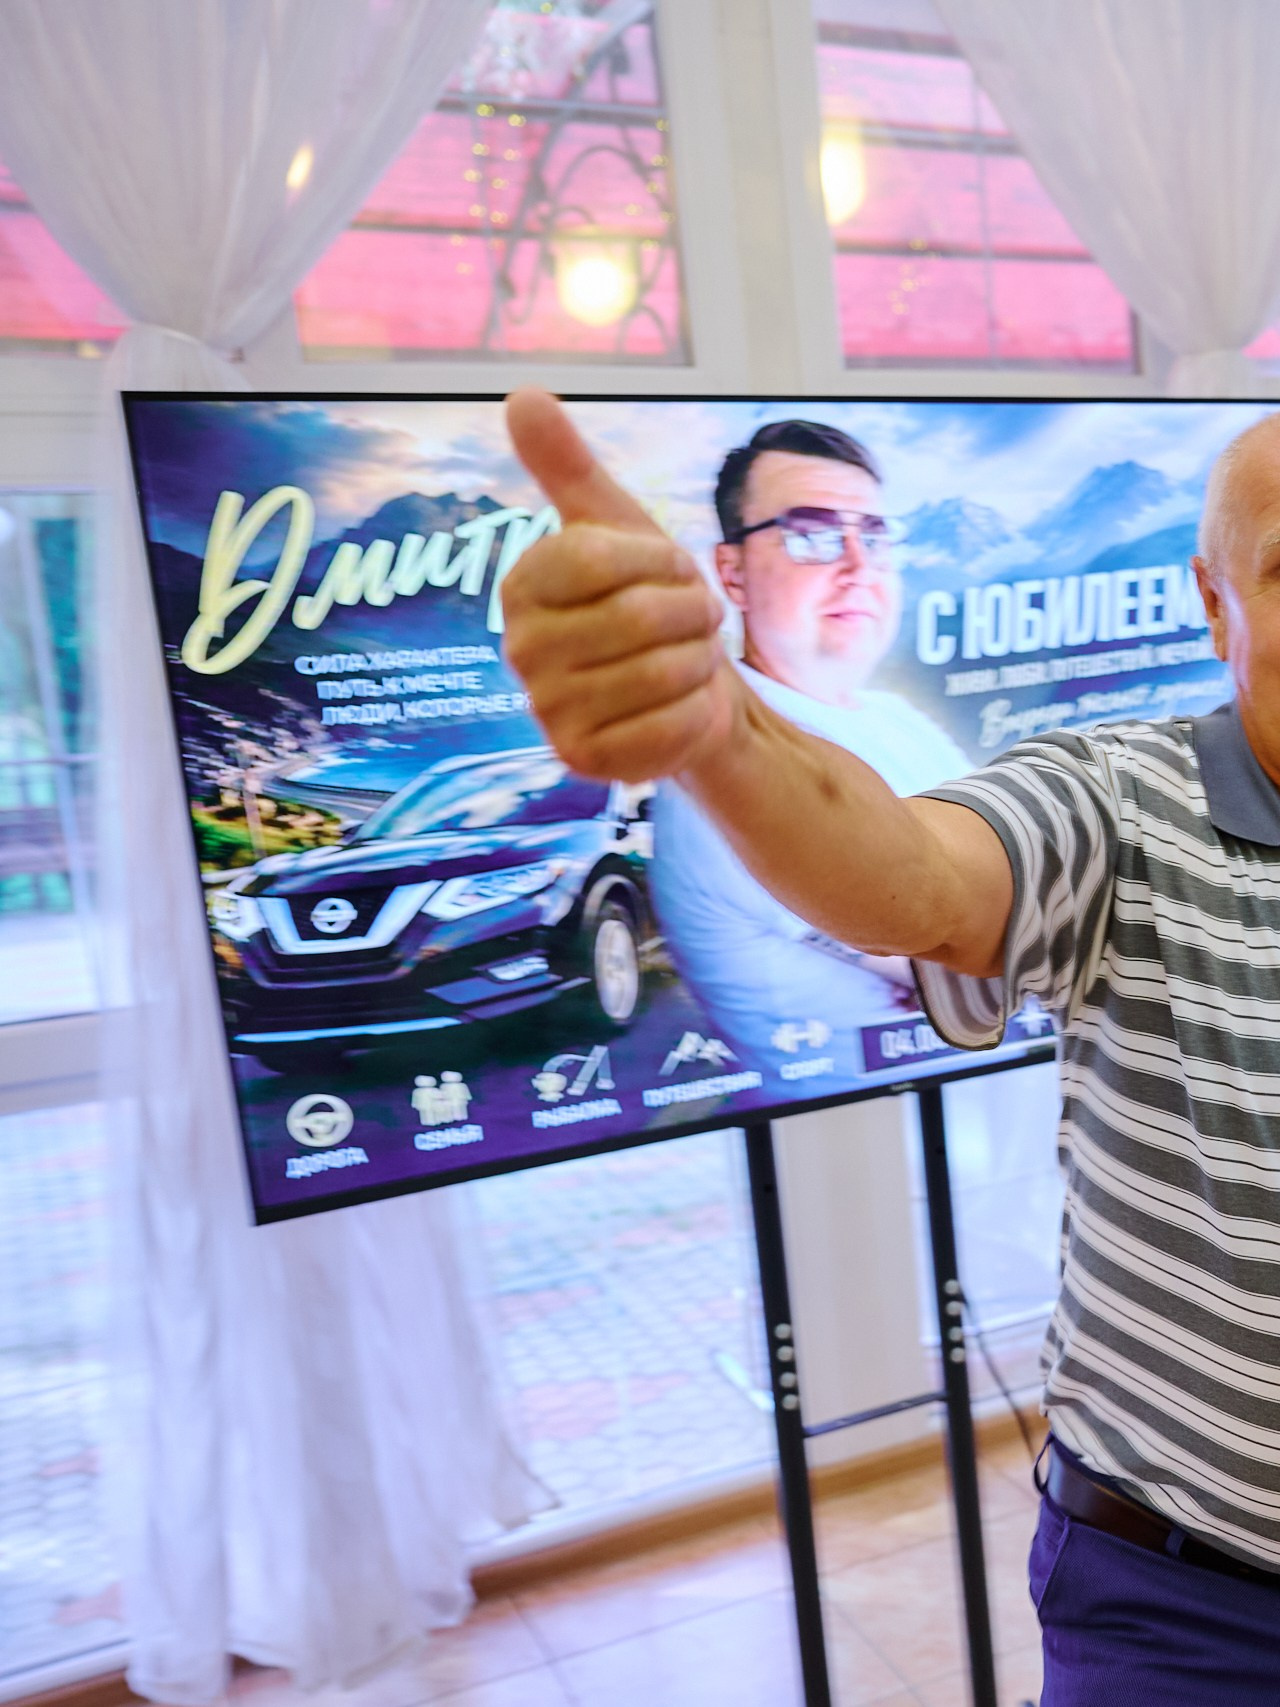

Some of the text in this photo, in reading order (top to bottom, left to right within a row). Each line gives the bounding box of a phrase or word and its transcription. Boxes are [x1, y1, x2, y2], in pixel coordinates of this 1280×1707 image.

[181, 485, 561, 674] Дмитр
[916, 564, 1208, 665] С ЮБИЛЕЕМ
